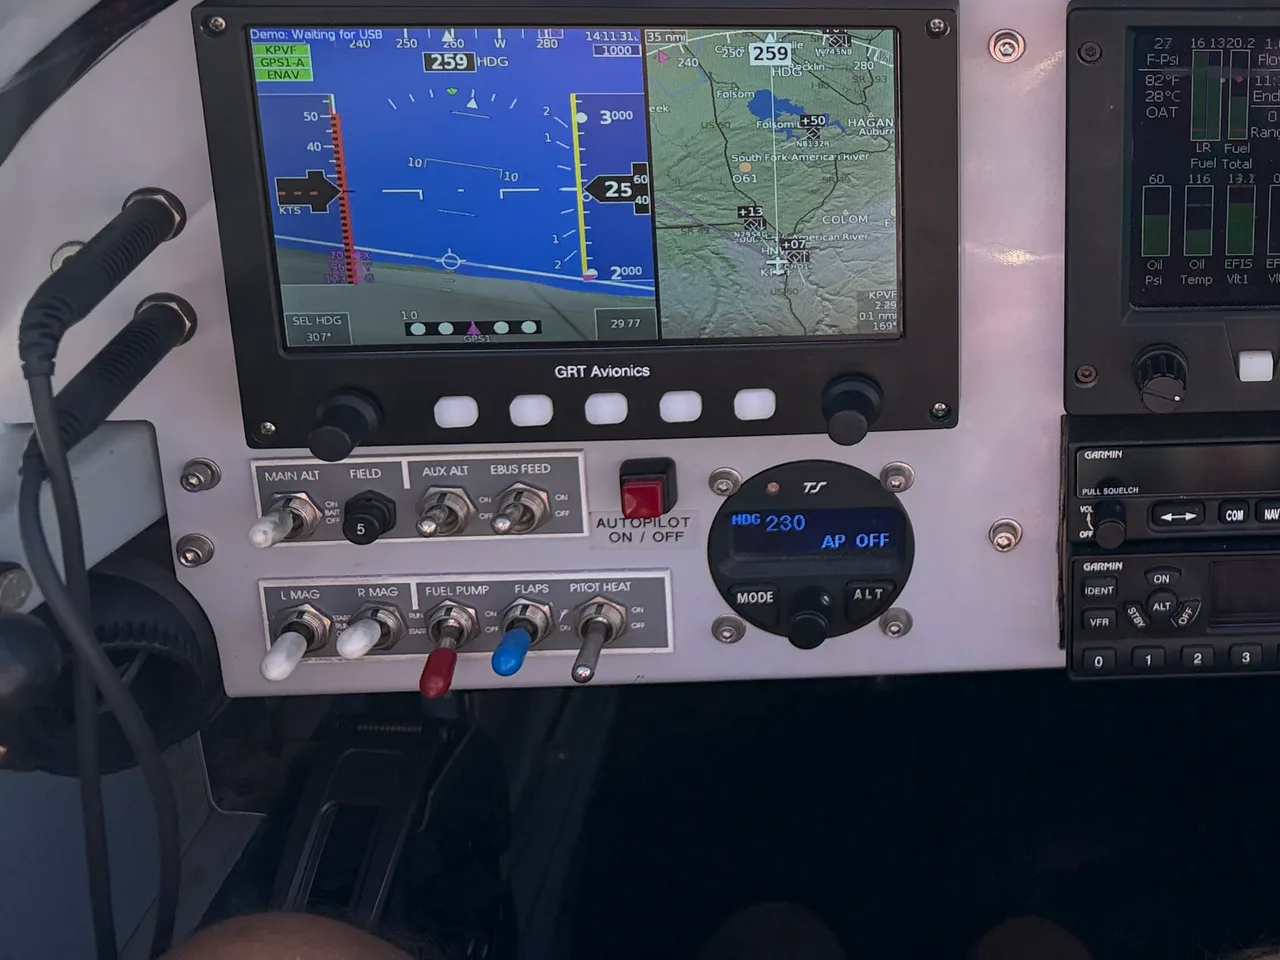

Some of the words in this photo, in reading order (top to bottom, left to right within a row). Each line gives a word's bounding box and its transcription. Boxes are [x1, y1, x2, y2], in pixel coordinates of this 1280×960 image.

[250, 29, 288, 39] Demo:
[291, 29, 336, 41] Waiting
[339, 29, 355, 39] for
[360, 29, 383, 39] USB
[396, 38, 417, 49] 250
[537, 38, 558, 49] 280
[1154, 38, 1172, 49] 27
[265, 45, 296, 55] KPVF
[603, 46, 632, 55] 1000
[754, 46, 788, 60] 259
[260, 58, 305, 68] GPS1-A
[431, 54, 468, 70] 259
[477, 56, 509, 68] HDG
[677, 58, 699, 67] 240
[853, 61, 874, 70] 280
[1147, 54, 1179, 66] F-Psi
[267, 70, 300, 80] ENAV
[717, 90, 755, 98] Folsom
[1146, 106, 1179, 118] OAT
[801, 116, 826, 125] +50
[1224, 143, 1250, 154] Fuel
[732, 153, 761, 162] South
[765, 153, 787, 162] Fork
[1191, 157, 1217, 169] Fuel
[1222, 157, 1253, 170] Total
[1149, 174, 1165, 184] 60
[1188, 173, 1211, 184] 116
[605, 181, 632, 197] 25
[279, 206, 301, 215] KTS
[739, 207, 763, 217] +13
[822, 214, 868, 224] COLOM
[782, 240, 806, 249] +07
[1147, 259, 1163, 270] Oil
[1189, 259, 1205, 270] Oil
[1225, 258, 1253, 269] EFIS
[1181, 274, 1213, 288] Temp
[293, 316, 312, 326] SEL
[316, 316, 342, 325] HDG
[610, 319, 641, 328] 29.77
[555, 365, 586, 378] GRT
[590, 364, 650, 378] Avionics
[1084, 450, 1123, 459] GARMIN
[350, 468, 381, 479] FIELD
[423, 466, 448, 477] AUX
[449, 465, 469, 475] ALT
[490, 464, 519, 475] EBUS
[521, 463, 551, 474] FEED
[265, 471, 298, 481] MAIN
[300, 470, 320, 480] ALT
[1082, 488, 1102, 496] PULL
[1103, 486, 1139, 495] SQUELCH
[1225, 508, 1244, 522] COM
[1264, 507, 1280, 520] NAV
[596, 517, 691, 530] AUTOPILOT
[731, 513, 760, 526] HDG
[766, 514, 806, 532] 230
[357, 524, 365, 535] 5
[608, 532, 631, 543] ON
[652, 531, 685, 542] OFF
[821, 534, 846, 549] AP
[855, 533, 890, 548] OFF
[1083, 561, 1123, 572] GARMIN
[1154, 574, 1170, 584] ON
[357, 588, 364, 597] R
[367, 587, 398, 597] MAG
[425, 585, 454, 596] FUEL
[456, 585, 490, 595] PUMP
[515, 584, 549, 594] FLAPS
[570, 582, 601, 593] PITOT
[603, 582, 632, 592] HEAT
[1084, 586, 1114, 596] IDENT
[737, 591, 773, 604] MODE
[854, 588, 883, 601] ALT
[1153, 602, 1171, 611] ALT
[1090, 617, 1109, 627] VFR
[1127, 606, 1146, 628] STBY
[1178, 607, 1194, 626] OFF
